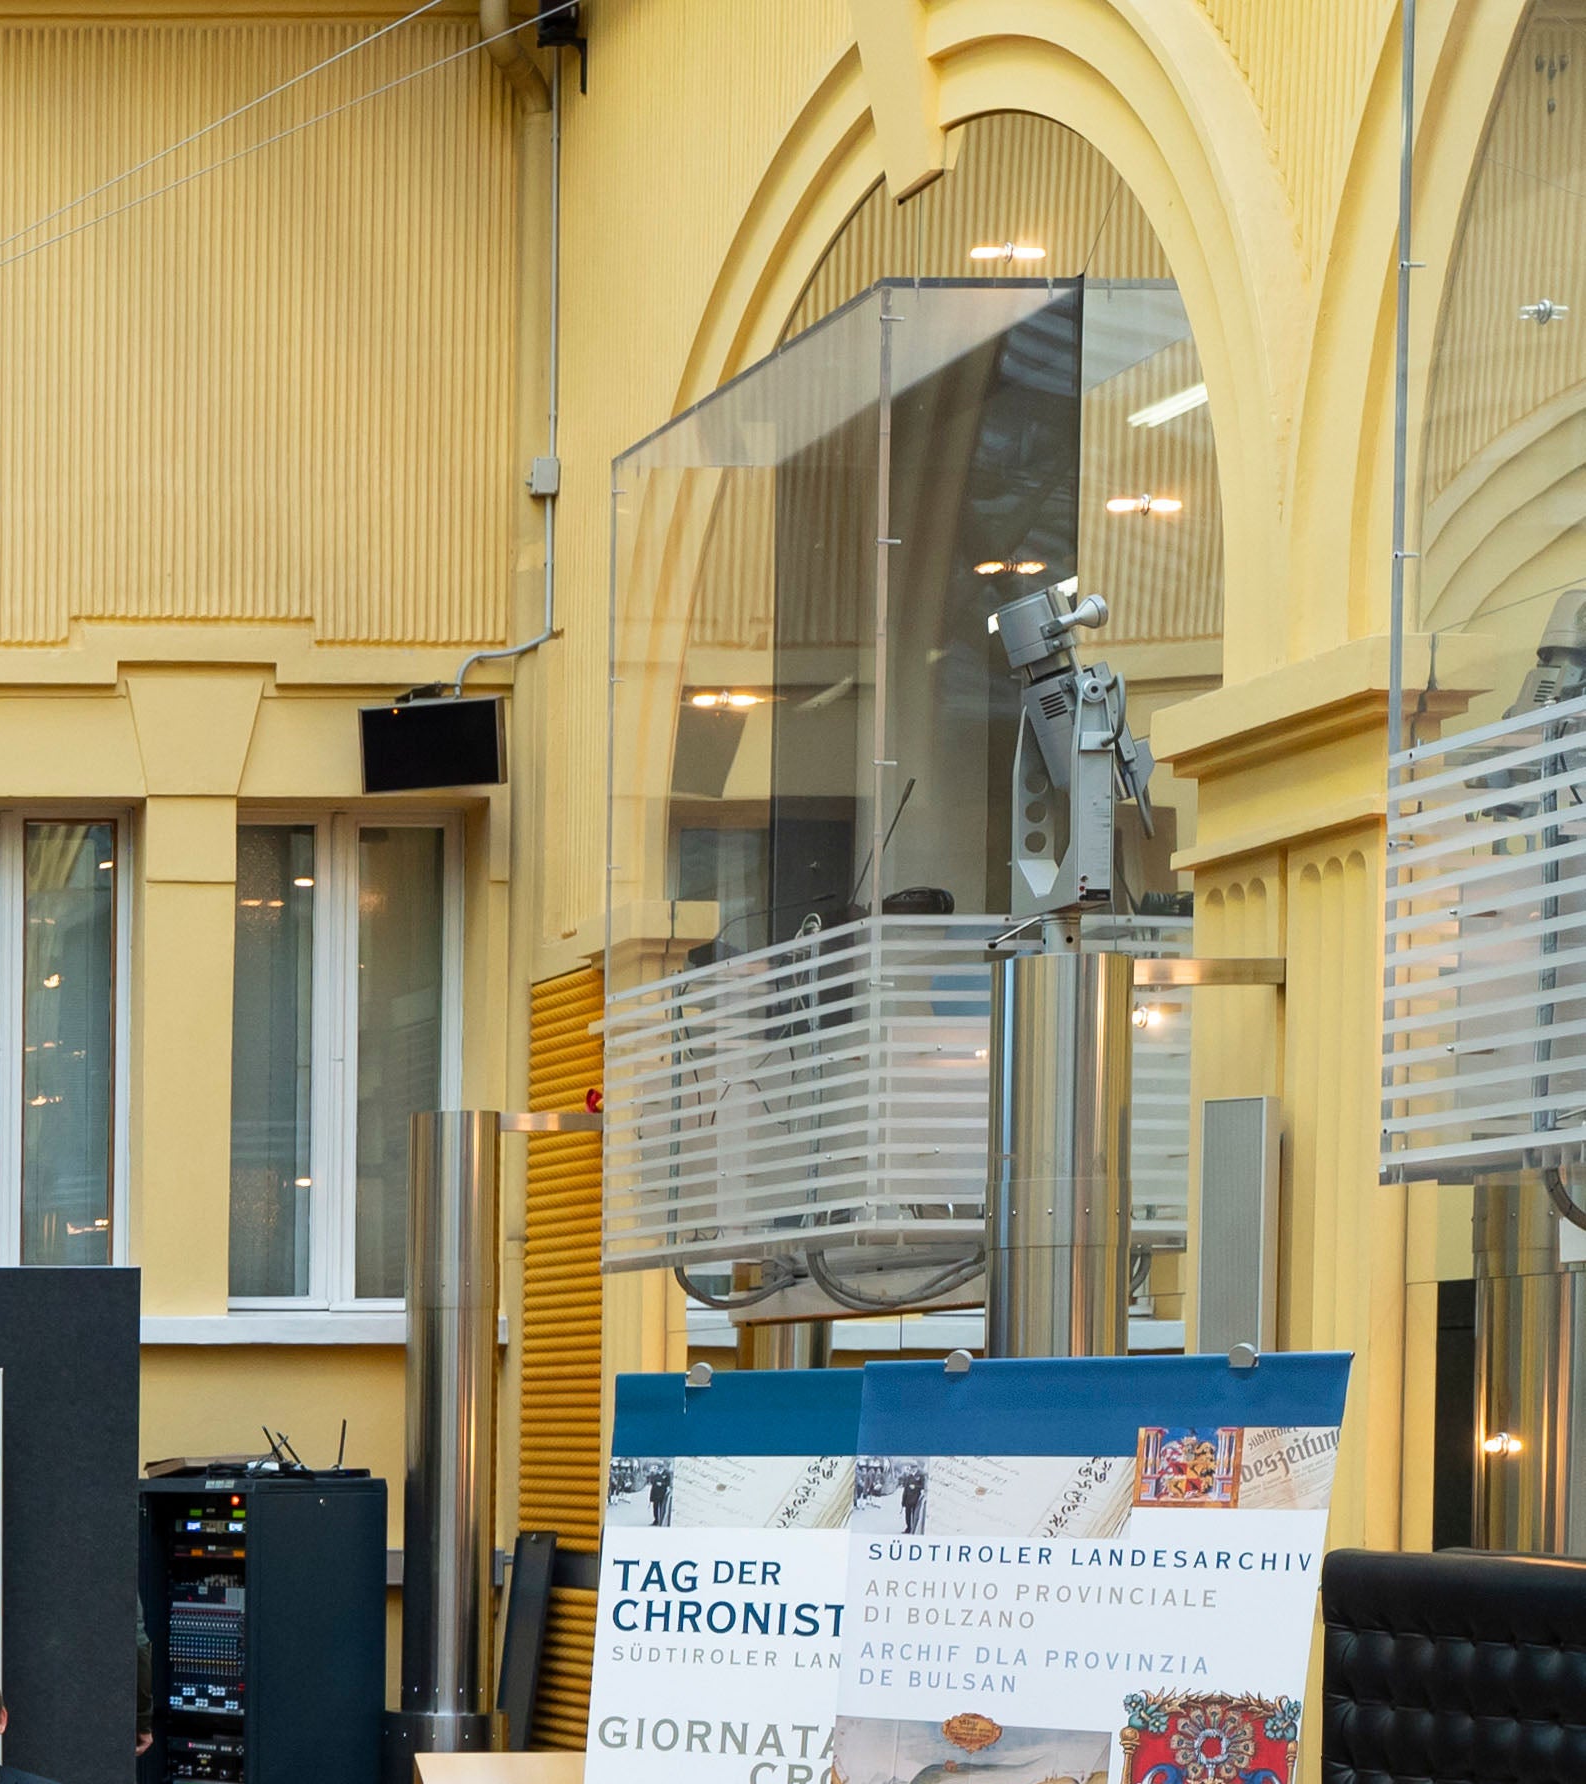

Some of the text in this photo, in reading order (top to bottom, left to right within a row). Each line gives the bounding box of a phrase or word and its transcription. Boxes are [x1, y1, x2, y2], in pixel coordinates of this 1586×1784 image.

[869, 1540, 1312, 1572] SÜDTIROLER LANDESARCHIV
[613, 1559, 782, 1593] TAG DER
[865, 1579, 1218, 1608] ARCHIVIO PROVINCIALE
[864, 1606, 1034, 1629] DI BOLZANO
[612, 1643, 778, 1666] SÜDTIROLER
[860, 1641, 1208, 1674] ARCHIF DLA PROVINZIA
[859, 1669, 1017, 1693] DE BULSAN
